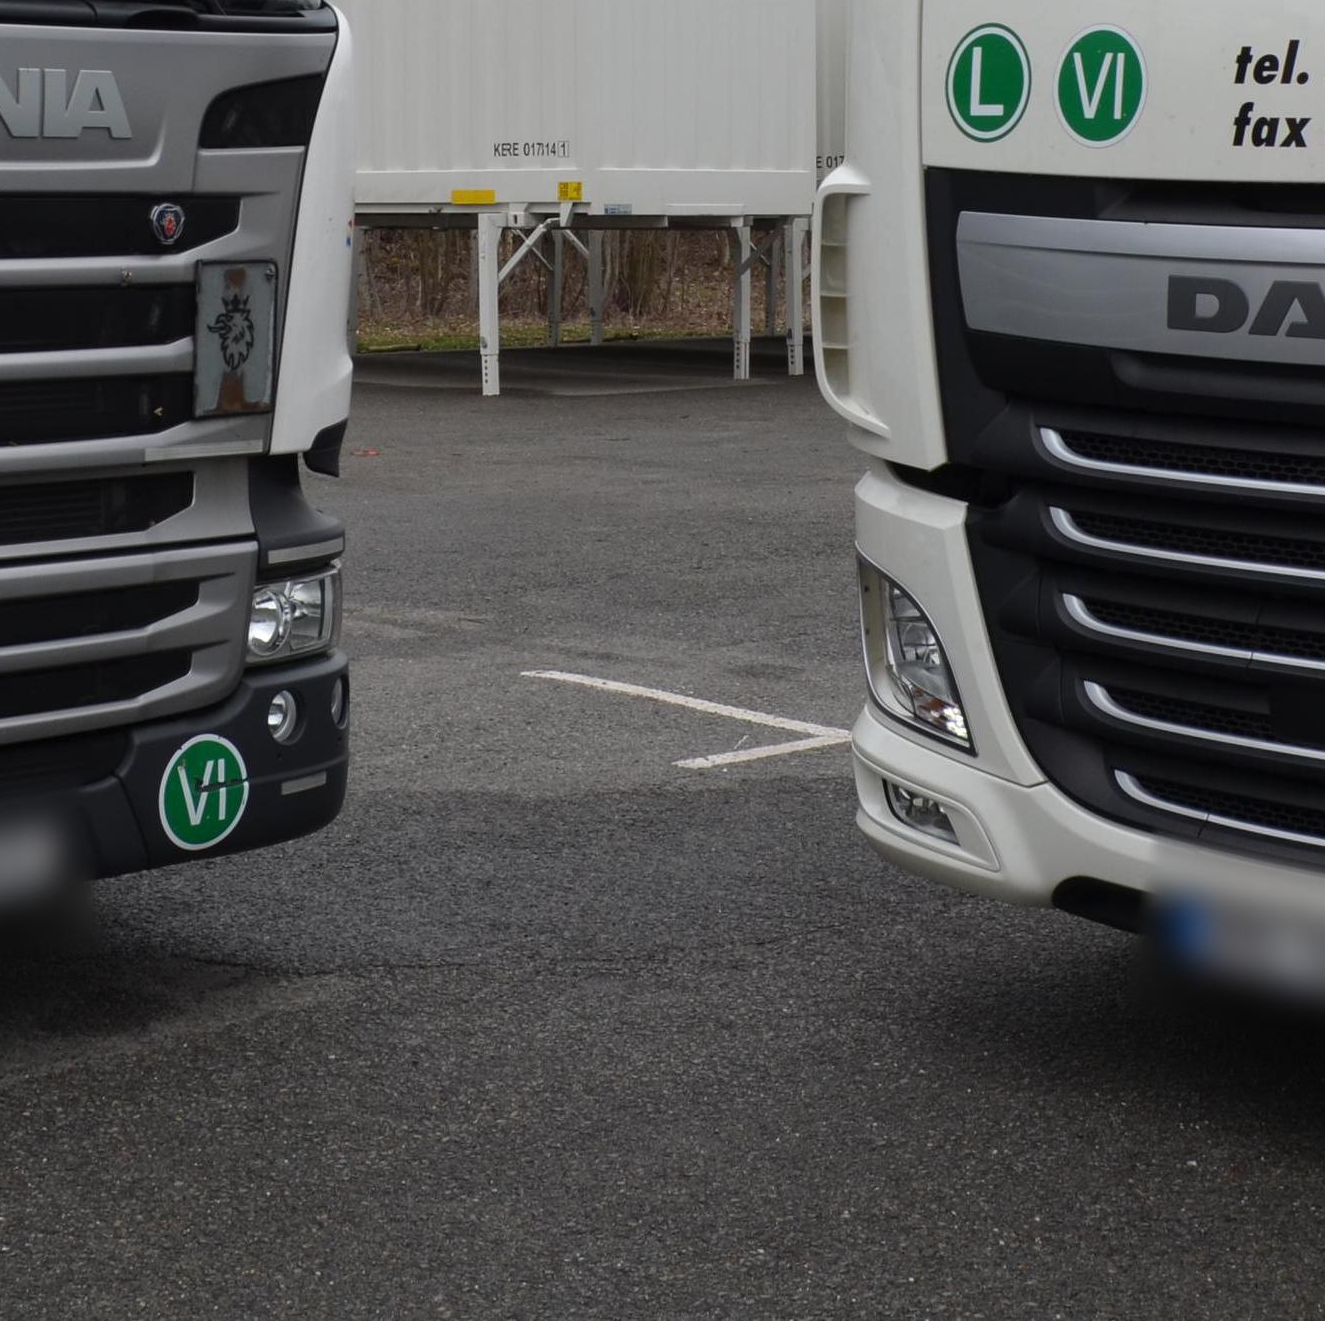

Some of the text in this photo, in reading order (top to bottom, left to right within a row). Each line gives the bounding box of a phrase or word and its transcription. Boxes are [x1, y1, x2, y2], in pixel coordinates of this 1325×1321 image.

[969, 46, 1004, 118] L
[1073, 50, 1125, 120] VI
[1234, 44, 1309, 85] tel.
[493, 143, 519, 157] KERE
[1231, 103, 1309, 149] fax
[177, 758, 226, 826] VI
